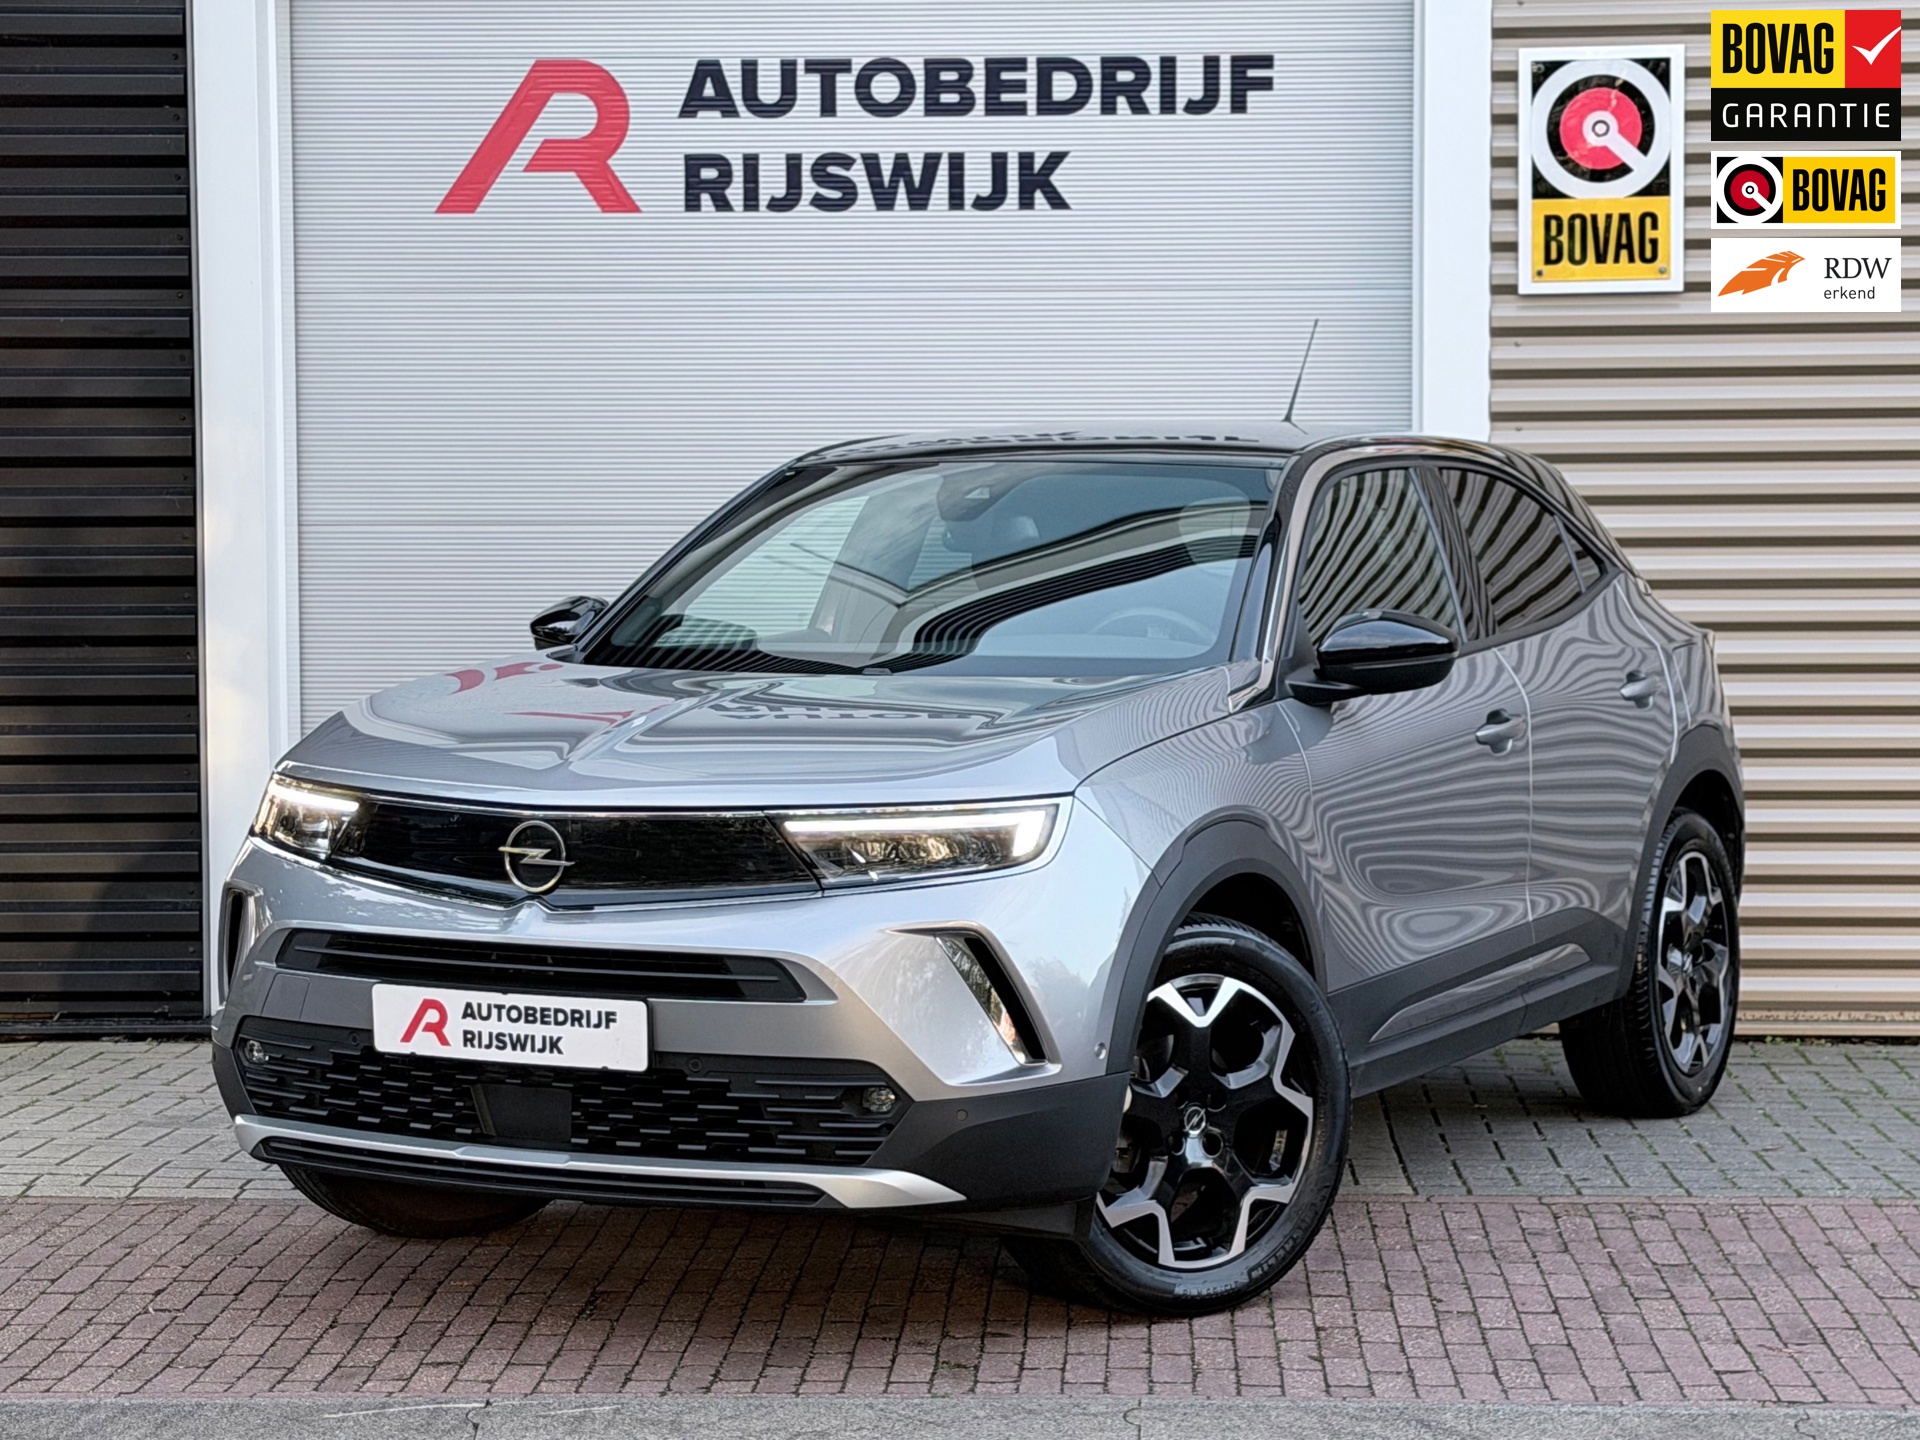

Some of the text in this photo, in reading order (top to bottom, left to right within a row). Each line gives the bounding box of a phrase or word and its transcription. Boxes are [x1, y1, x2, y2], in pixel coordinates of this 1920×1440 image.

[678, 54, 1275, 119] AUTOBEDRIJF
[683, 151, 1073, 213] RIJSWIJK
[1543, 211, 1659, 266] BOVAG
[461, 1001, 617, 1029] AUTOBEDRIJF
[462, 1029, 564, 1055] RIJSWIJK
